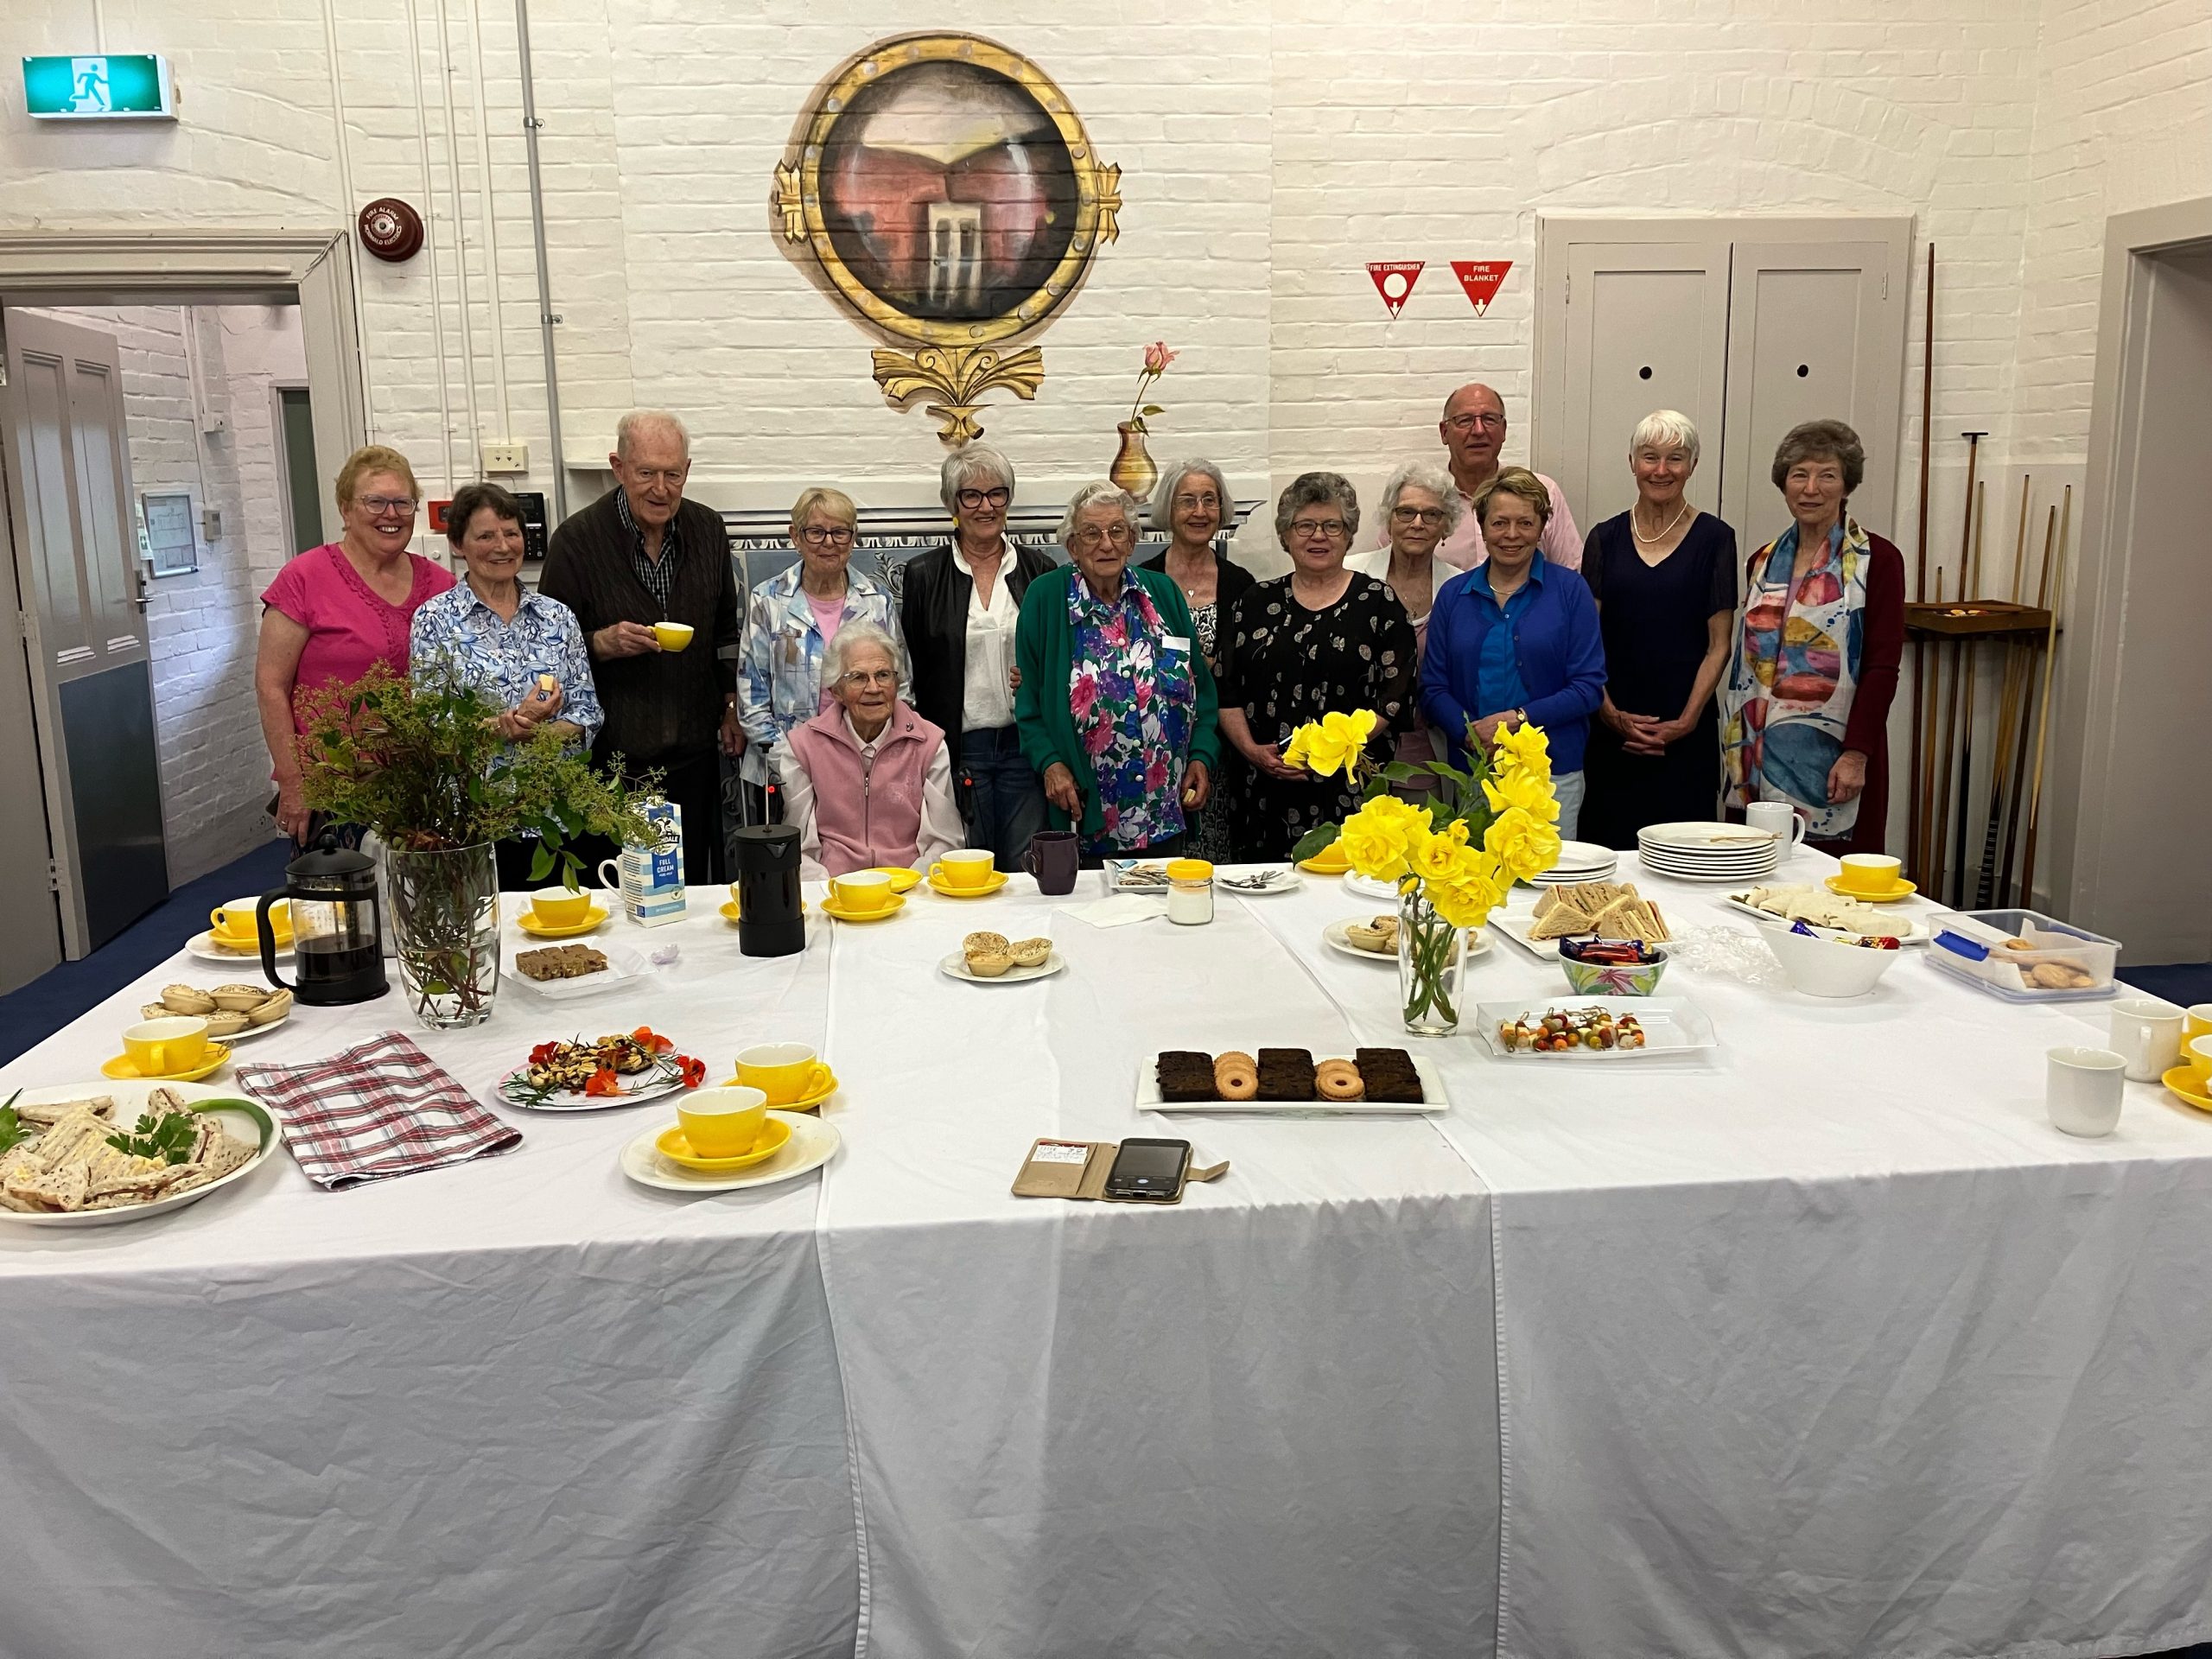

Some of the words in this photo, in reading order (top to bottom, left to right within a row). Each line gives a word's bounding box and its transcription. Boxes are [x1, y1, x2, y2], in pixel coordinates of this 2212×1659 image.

[365, 208, 378, 219] FIRE
[378, 207, 399, 220] ALARM
[1382, 263, 1421, 271] EXTINGUISHER
[658, 858, 671, 867] FULL
[657, 864, 674, 874] CREAM
